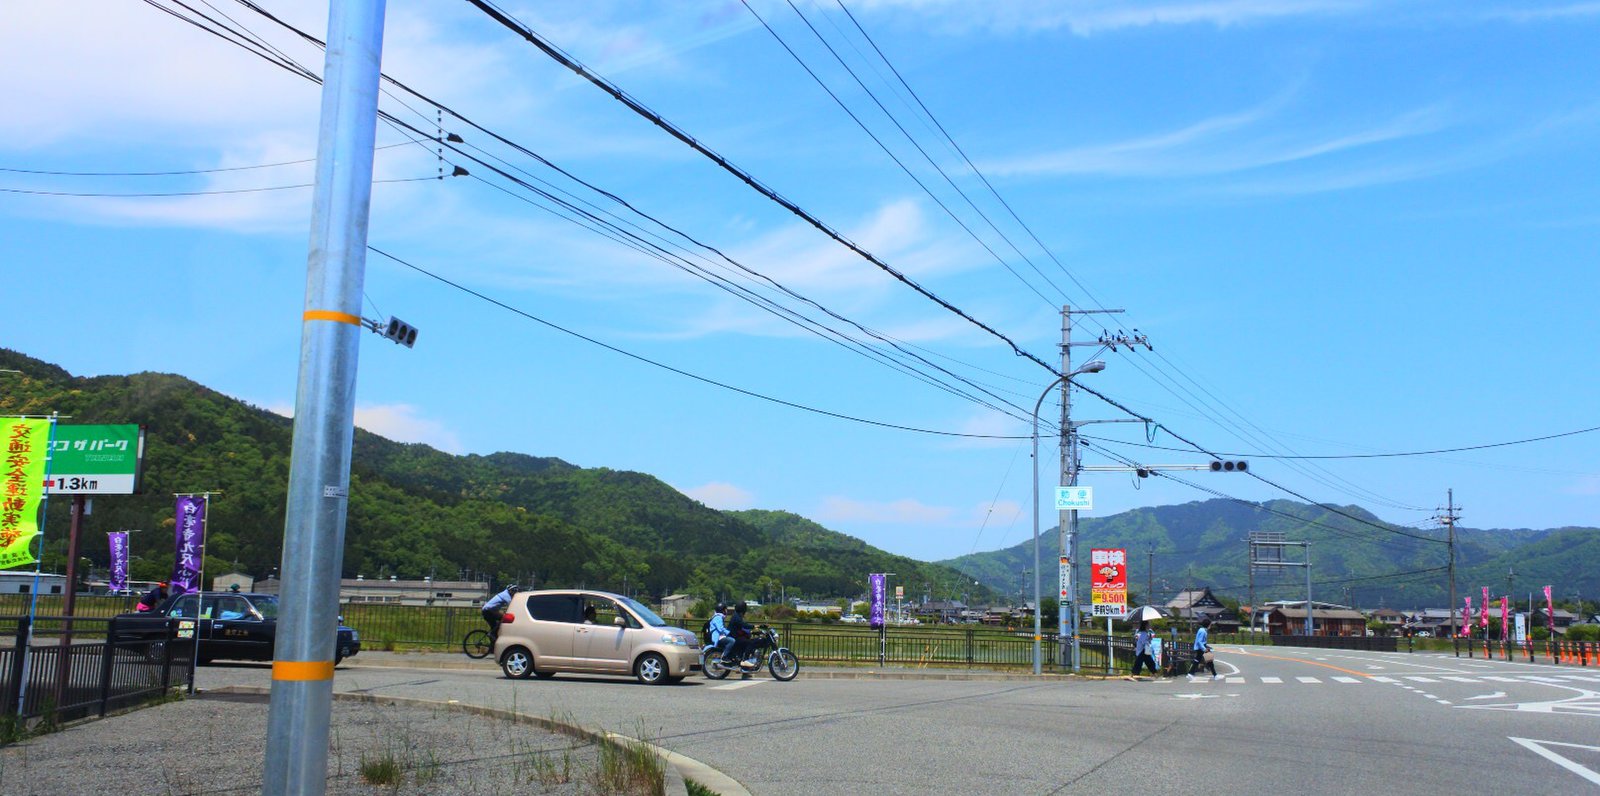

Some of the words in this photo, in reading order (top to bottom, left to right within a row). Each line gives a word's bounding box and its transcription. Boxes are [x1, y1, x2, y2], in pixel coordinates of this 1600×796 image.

[89, 438, 128, 451] パーク
[57, 477, 98, 490] 1.3km
[1092, 551, 1125, 566] 車検
